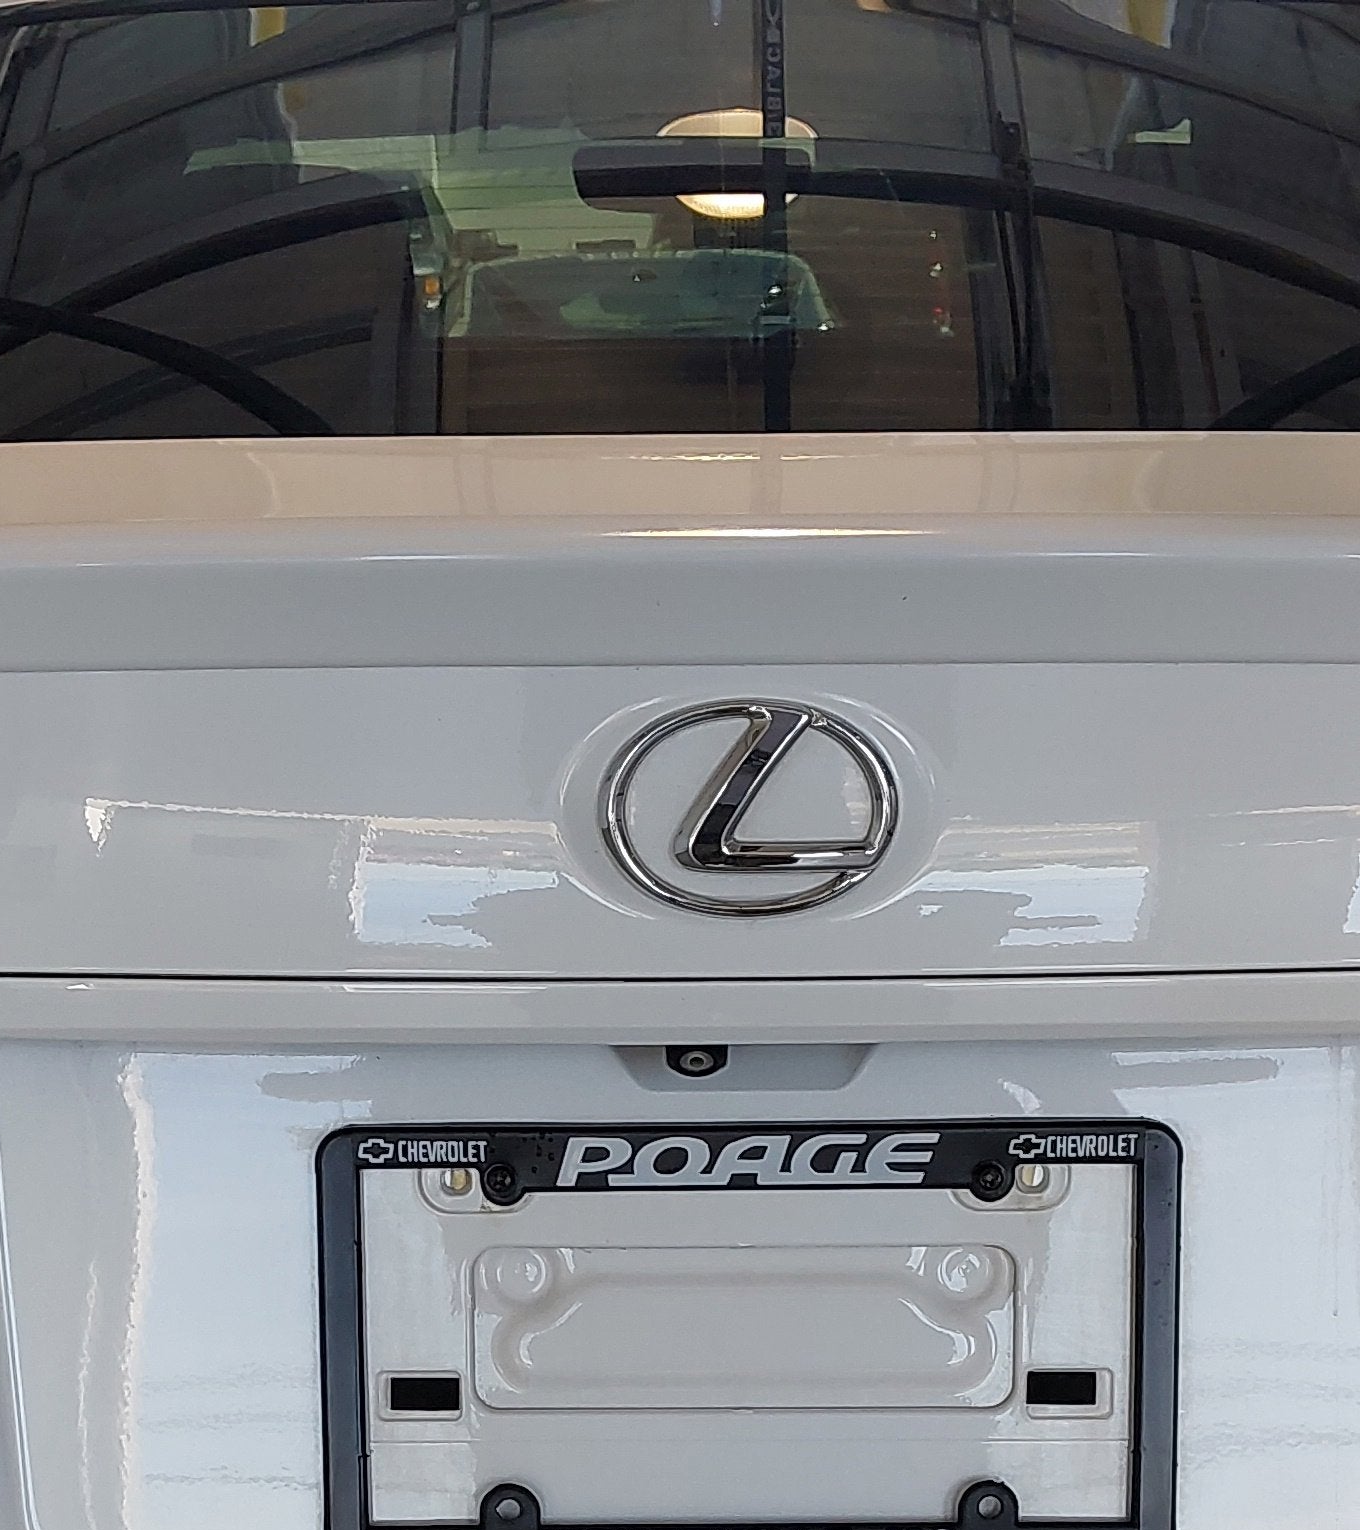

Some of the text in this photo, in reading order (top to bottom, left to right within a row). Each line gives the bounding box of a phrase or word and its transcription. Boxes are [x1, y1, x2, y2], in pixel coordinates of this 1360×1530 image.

[397, 1140, 487, 1163] CHEVROLET
[1045, 1133, 1138, 1159] CHEVROLET
[555, 1132, 941, 1188] POAGE
